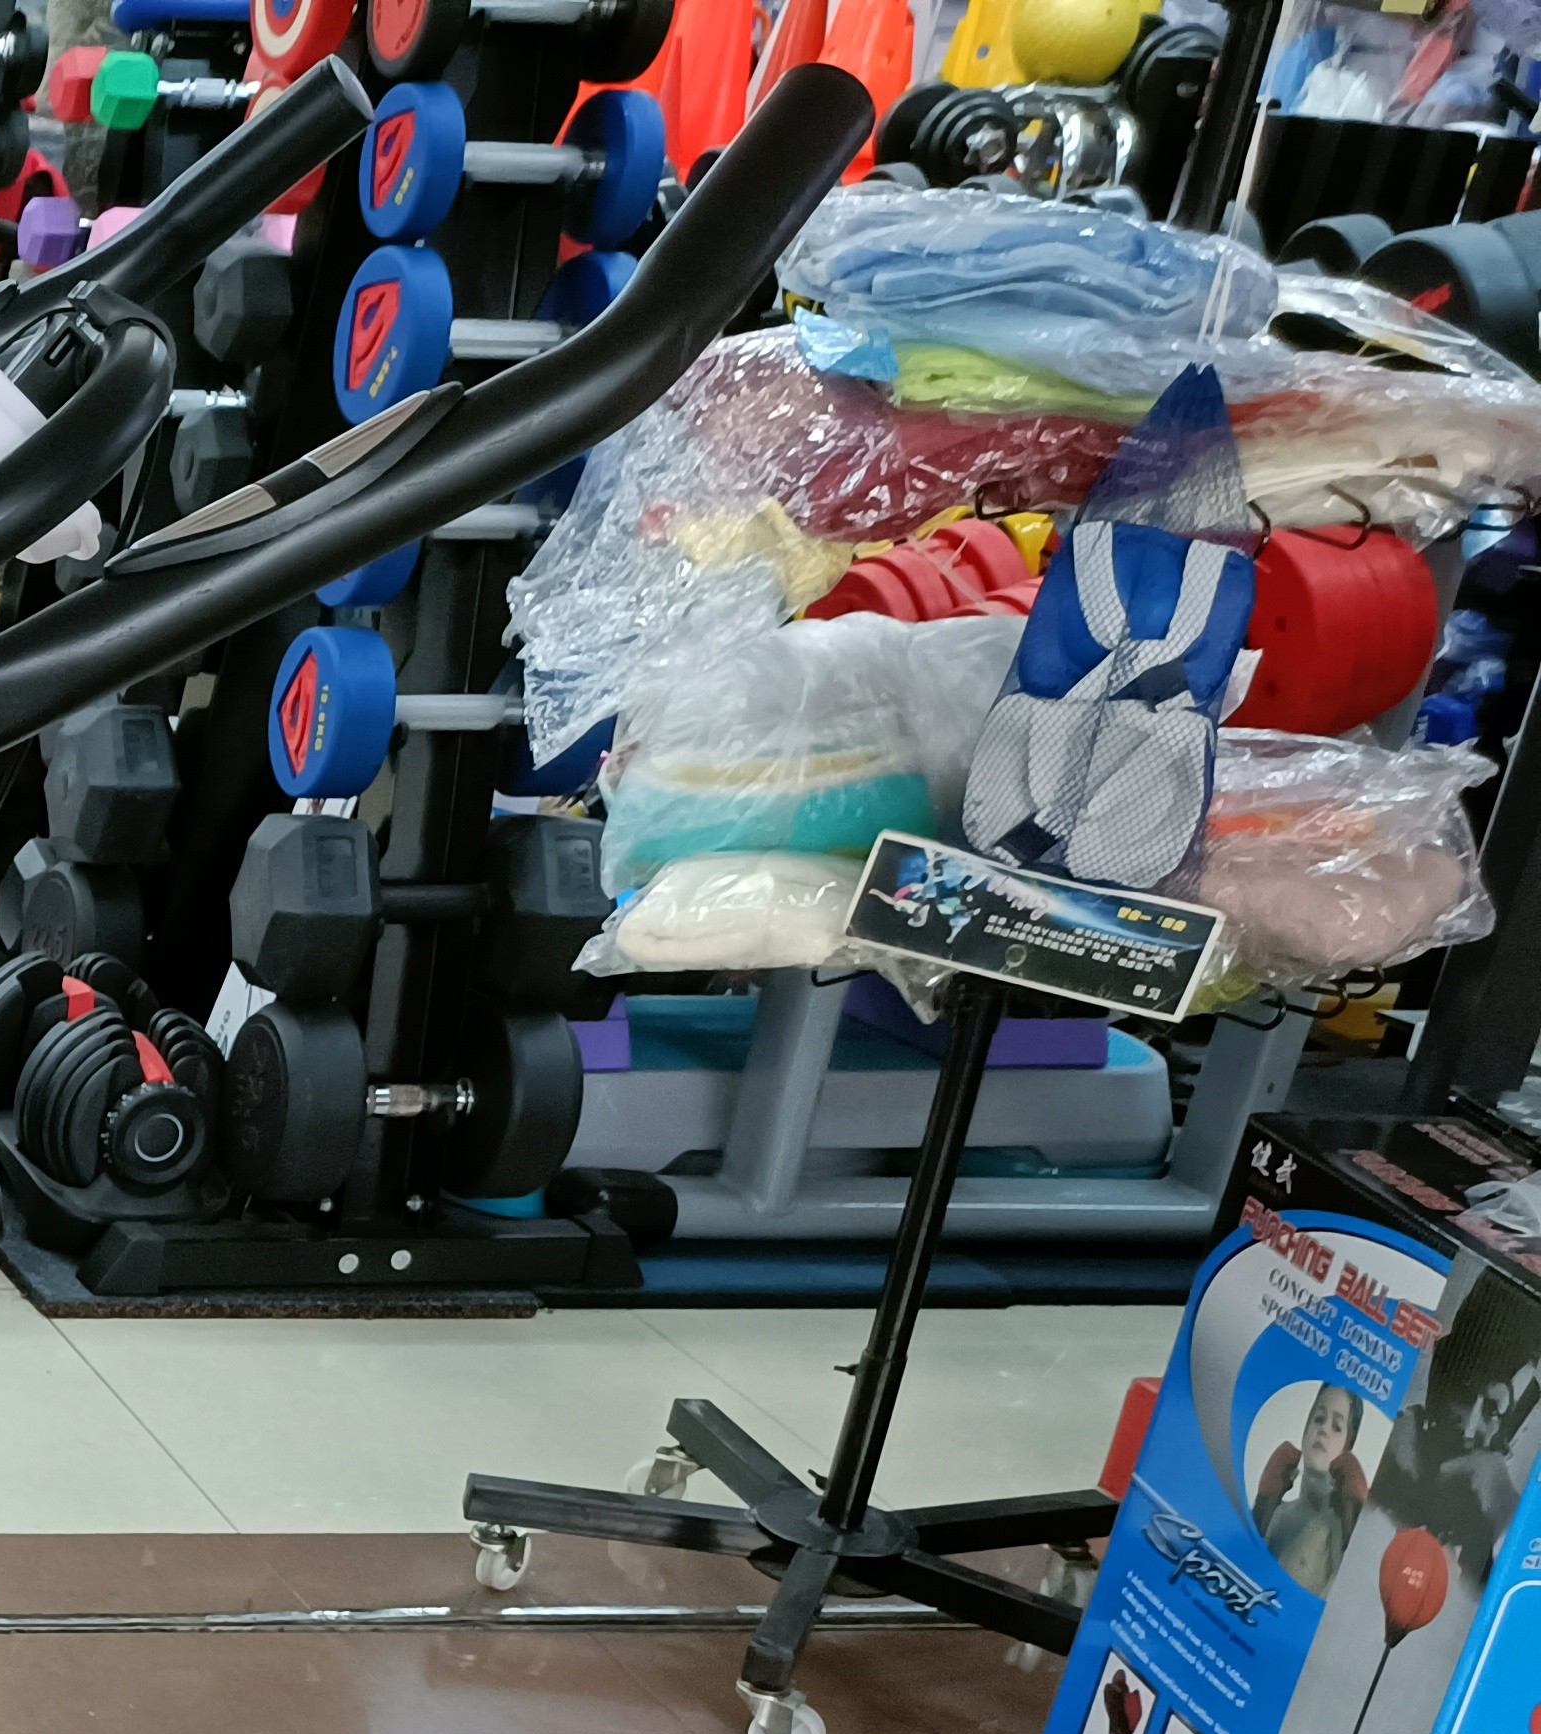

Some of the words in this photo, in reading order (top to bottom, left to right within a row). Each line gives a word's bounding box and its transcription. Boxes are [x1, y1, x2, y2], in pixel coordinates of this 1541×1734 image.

[1238, 1195, 1336, 1284] PUNCHING
[1335, 1259, 1389, 1327] BALL
[1390, 1298, 1442, 1354] SET
[1268, 1268, 1337, 1327] CONCEPT
